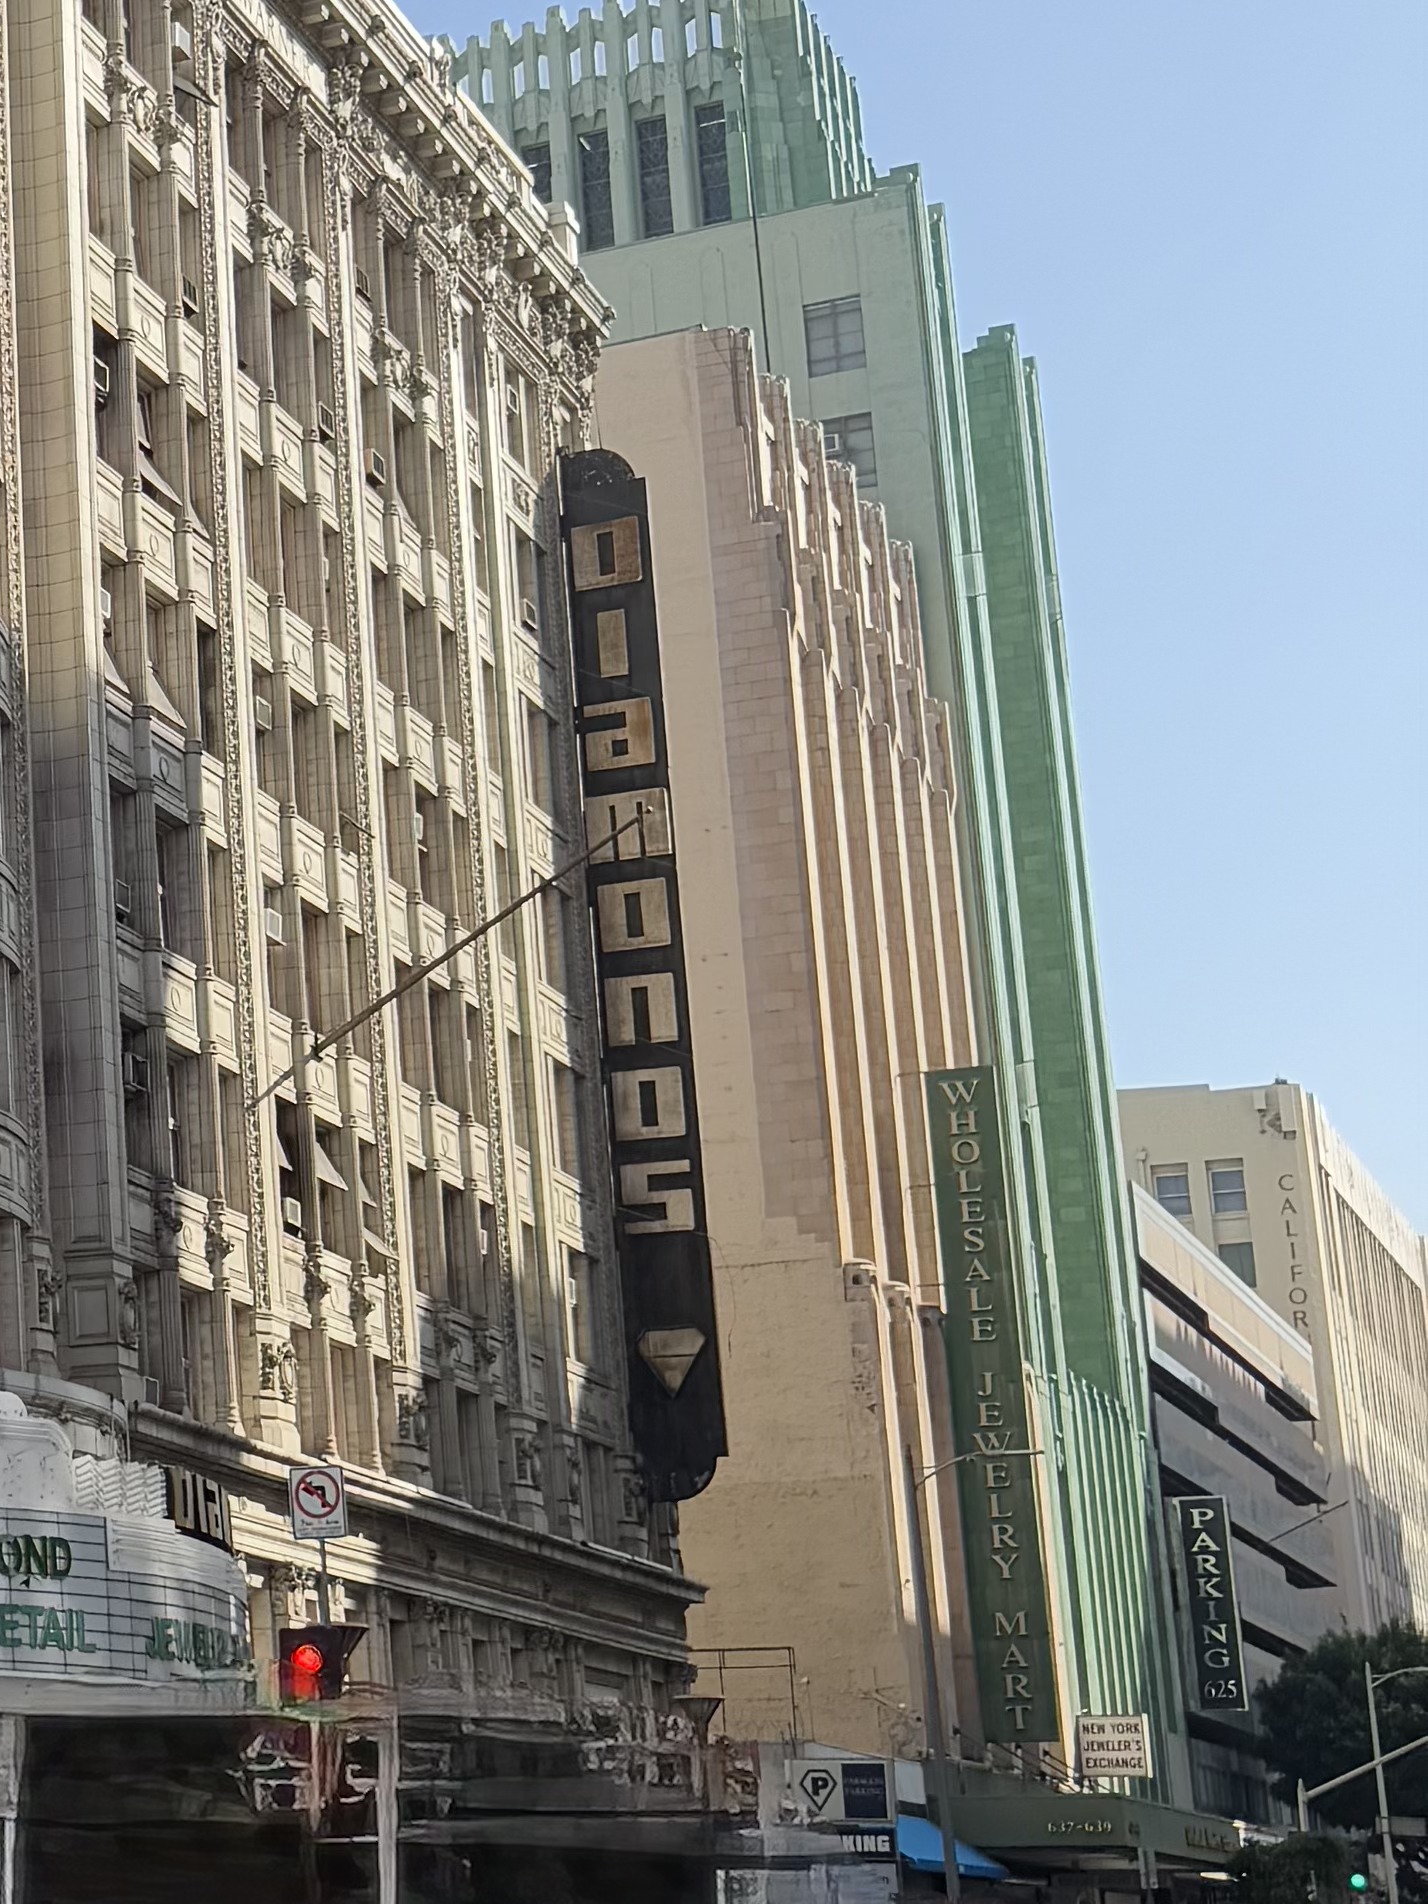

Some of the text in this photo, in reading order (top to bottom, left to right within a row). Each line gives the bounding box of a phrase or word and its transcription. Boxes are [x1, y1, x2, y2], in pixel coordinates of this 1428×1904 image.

[1277, 1173, 1313, 1346] CALIFOR
[938, 1077, 1033, 1734] WHOLESALE JEWELRY MART
[1189, 1508, 1231, 1669] PARKING
[1204, 1680, 1237, 1699] 625
[1082, 1722, 1140, 1735] NEW YORK
[1083, 1739, 1142, 1752] JEWELER'S
[1085, 1756, 1144, 1770] EXCHANGE
